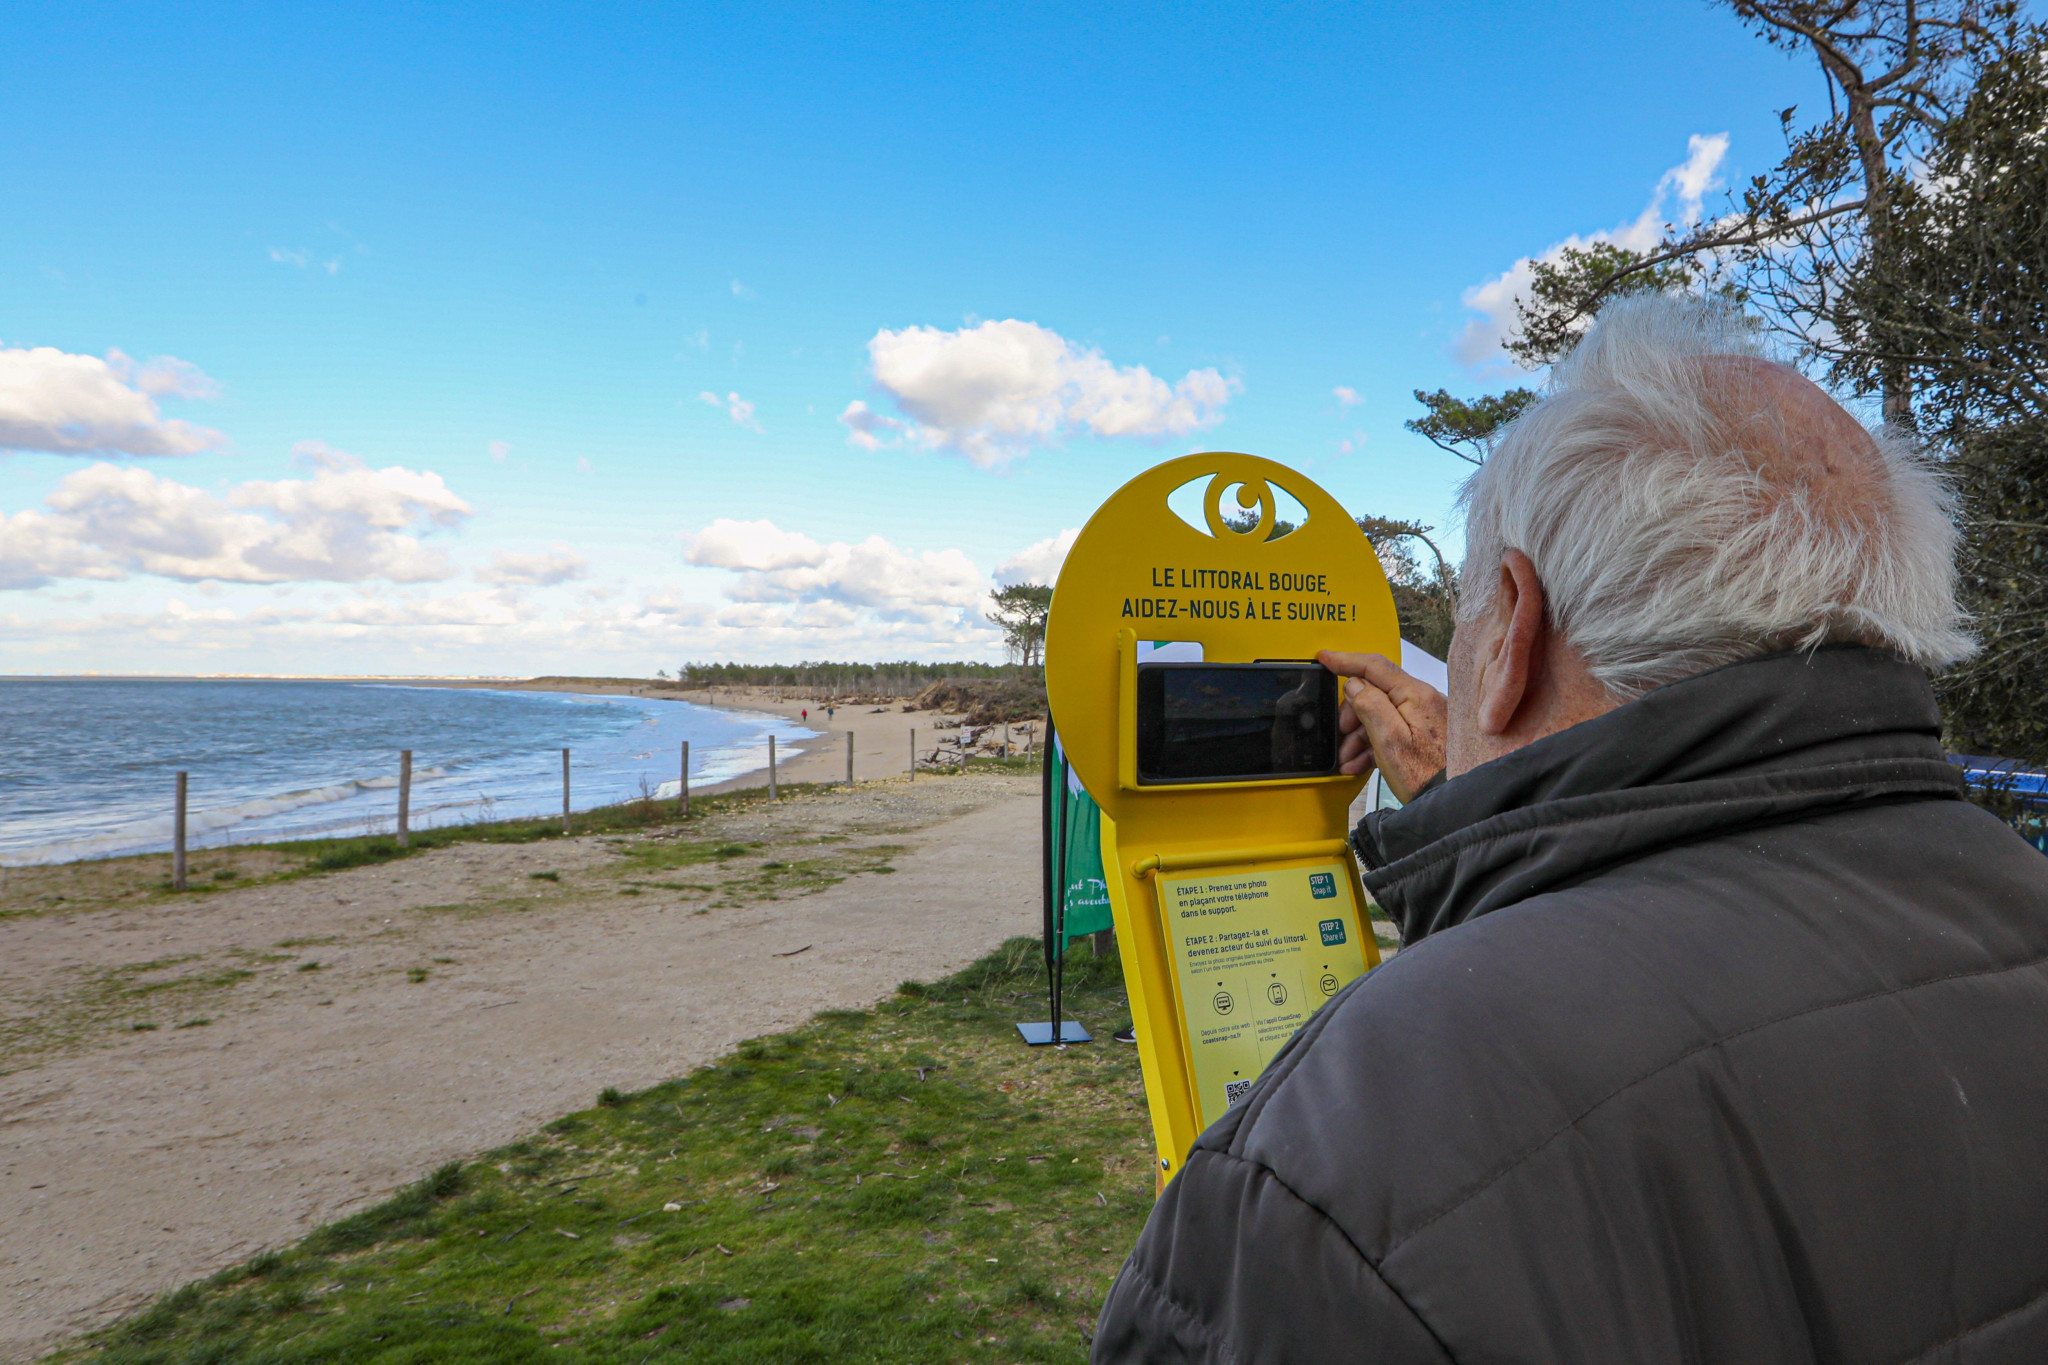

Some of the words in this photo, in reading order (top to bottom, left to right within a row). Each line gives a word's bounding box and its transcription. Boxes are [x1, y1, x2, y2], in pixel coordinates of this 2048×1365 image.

[1152, 568, 1175, 588] LE
[1181, 568, 1265, 591] LITTORAL
[1269, 572, 1331, 596] BOUGE,
[1121, 598, 1240, 619] AIDEZ-NOUS
[1245, 597, 1256, 620] À
[1261, 601, 1281, 620] LE
[1287, 602, 1347, 622] SUIVRE
[1176, 886, 1199, 896] ÉTAPE
[1199, 885, 1204, 894] 1
[1208, 883, 1232, 893] Prenez
[1233, 882, 1247, 890] une
[1248, 880, 1267, 891] photo
[1310, 875, 1324, 885] STEP
[1324, 875, 1329, 883] 1
[1312, 886, 1326, 896] Snap
[1326, 885, 1331, 894] it
[1178, 899, 1189, 907] en
[1190, 895, 1216, 908] plaçant
[1216, 894, 1235, 903] votre
[1235, 890, 1269, 902] téléphone
[1180, 908, 1199, 918] dans
[1199, 907, 1207, 916] le
[1208, 904, 1237, 916] support.
[1320, 922, 1334, 932] STEP
[1334, 921, 1339, 930] 2
[1185, 936, 1208, 946] ÉTAPE
[1208, 935, 1214, 943] 2
[1219, 928, 1261, 943] Partagez-la
[1261, 927, 1269, 936] et
[1322, 933, 1338, 942] Share
[1339, 931, 1344, 940] it
[1187, 945, 1219, 958] devenez
[1220, 943, 1243, 953] acteur
[1244, 940, 1255, 949] du
[1255, 938, 1272, 947] suivi
[1273, 936, 1283, 945] du
[1283, 933, 1308, 944] littoral.
